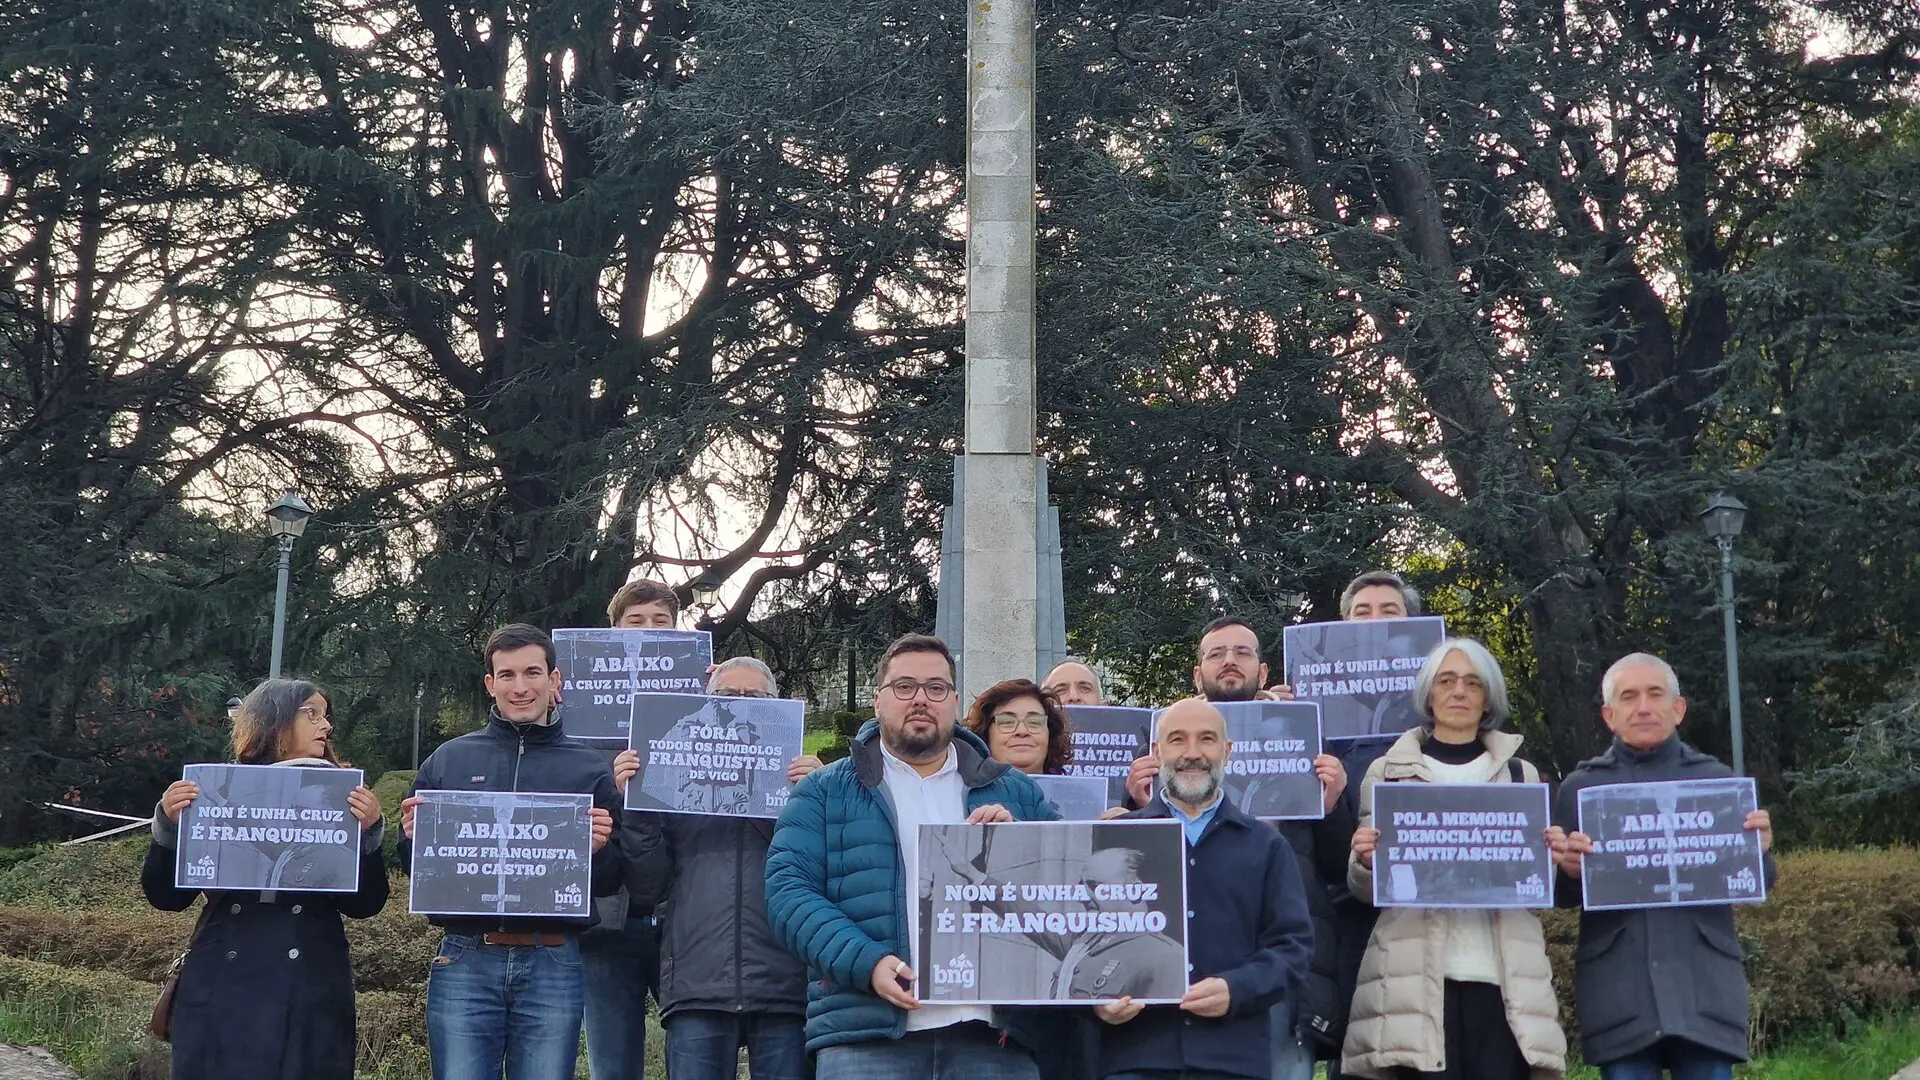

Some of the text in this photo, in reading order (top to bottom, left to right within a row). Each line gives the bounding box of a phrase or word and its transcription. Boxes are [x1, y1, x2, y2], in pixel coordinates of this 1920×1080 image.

[593, 656, 674, 673] ABAIXO
[1300, 662, 1331, 676] NON
[1335, 659, 1344, 674] É
[1346, 659, 1389, 672] UNHA
[564, 678, 701, 690] A CRUZ FRANQUISTA
[1296, 679, 1307, 698] É
[593, 693, 614, 704] DO
[689, 725, 739, 741] FÓRA
[649, 739, 783, 756] TODOS OS SÍMBOLOS
[1263, 739, 1306, 752] CRUZ
[649, 752, 781, 772] FRANQUISTAS
[689, 770, 739, 782] DE VIGO
[198, 804, 344, 822] NON É UNHA CRUZ
[1393, 811, 1529, 827] POLA MEMORIA
[1623, 810, 1715, 833] ABAIXO
[191, 822, 348, 844] É FRANQUISMO
[457, 822, 549, 840] ABAIXO
[1397, 827, 1526, 844] DEMOCRÁTICA
[1591, 833, 1747, 854] A CRUZ FRANQUISTA
[423, 846, 578, 860] A CRUZ FRANQUISTA
[1388, 846, 1536, 862] E ANTIFASCISTA
[1625, 850, 1717, 869] DO CASTRO
[187, 863, 216, 879] bng
[456, 863, 547, 876] DO CASTRO
[944, 880, 1158, 902] NON É UNHA CRUZ
[1515, 880, 1545, 898] bng
[1727, 875, 1757, 893] bng
[554, 890, 582, 907] bng
[936, 907, 1168, 936] É FRANQUISMO
[933, 964, 975, 989] bng
